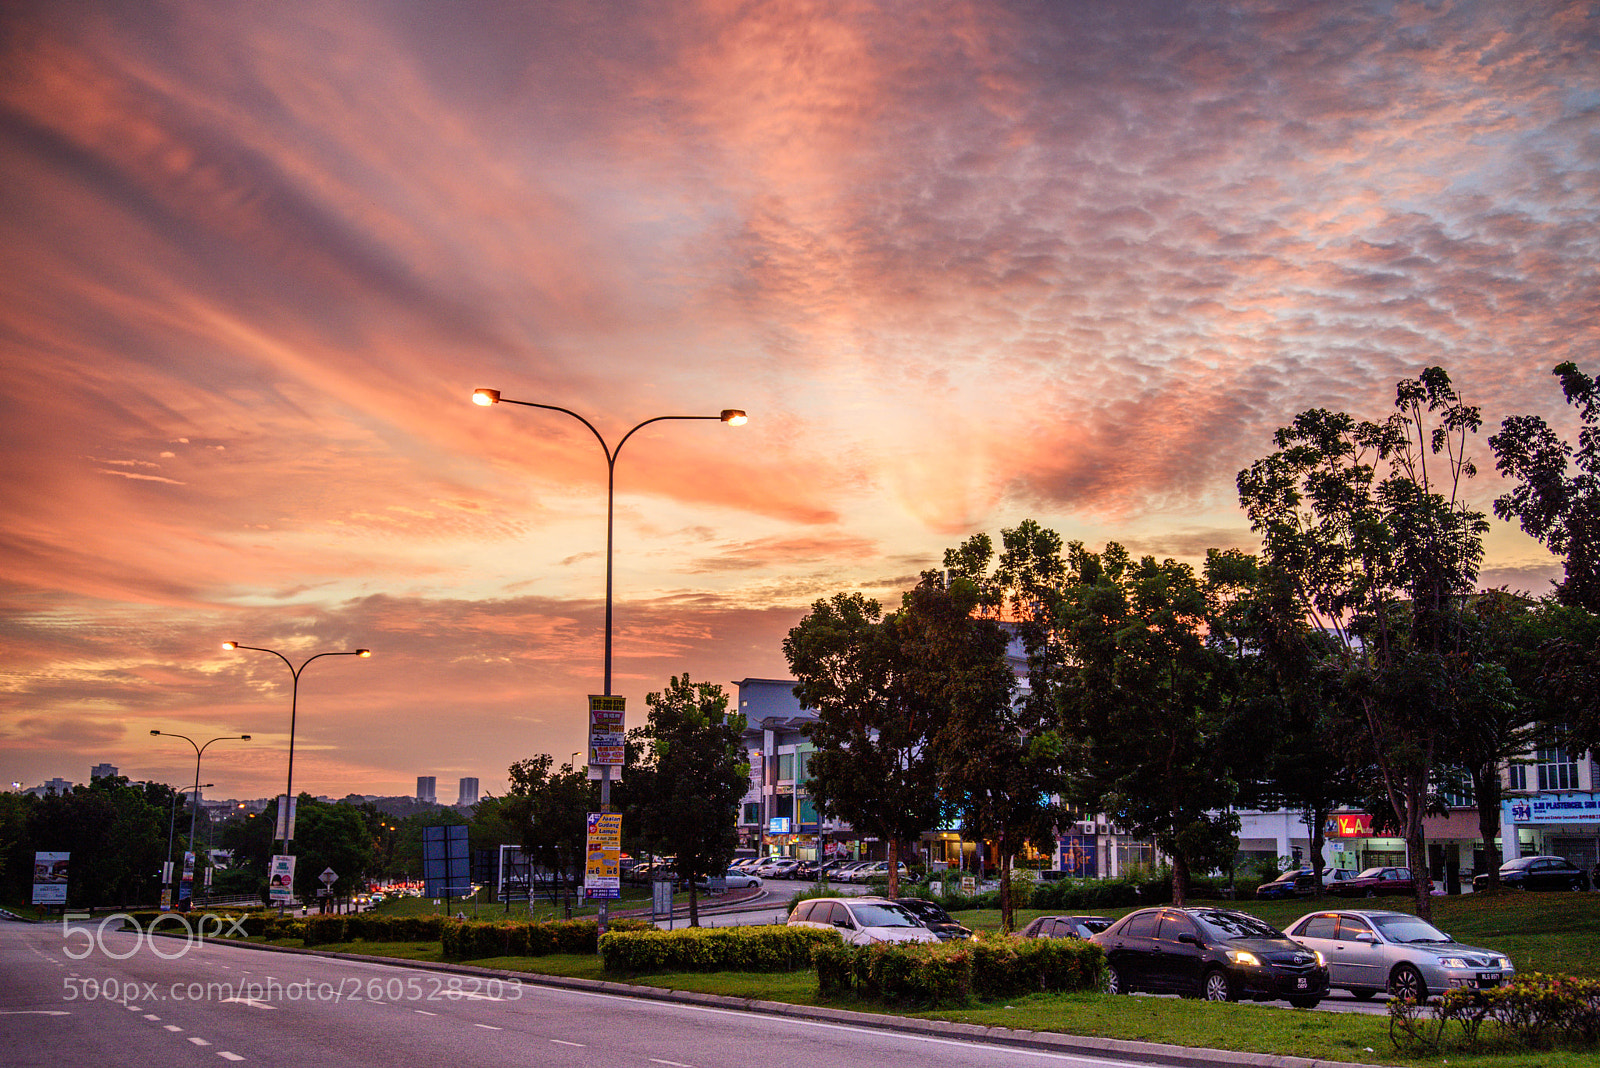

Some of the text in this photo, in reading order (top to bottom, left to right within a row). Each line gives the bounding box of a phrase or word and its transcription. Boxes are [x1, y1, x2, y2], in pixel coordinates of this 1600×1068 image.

[588, 813, 595, 823] 4
[595, 867, 600, 875] 6
[613, 867, 618, 875] 8
